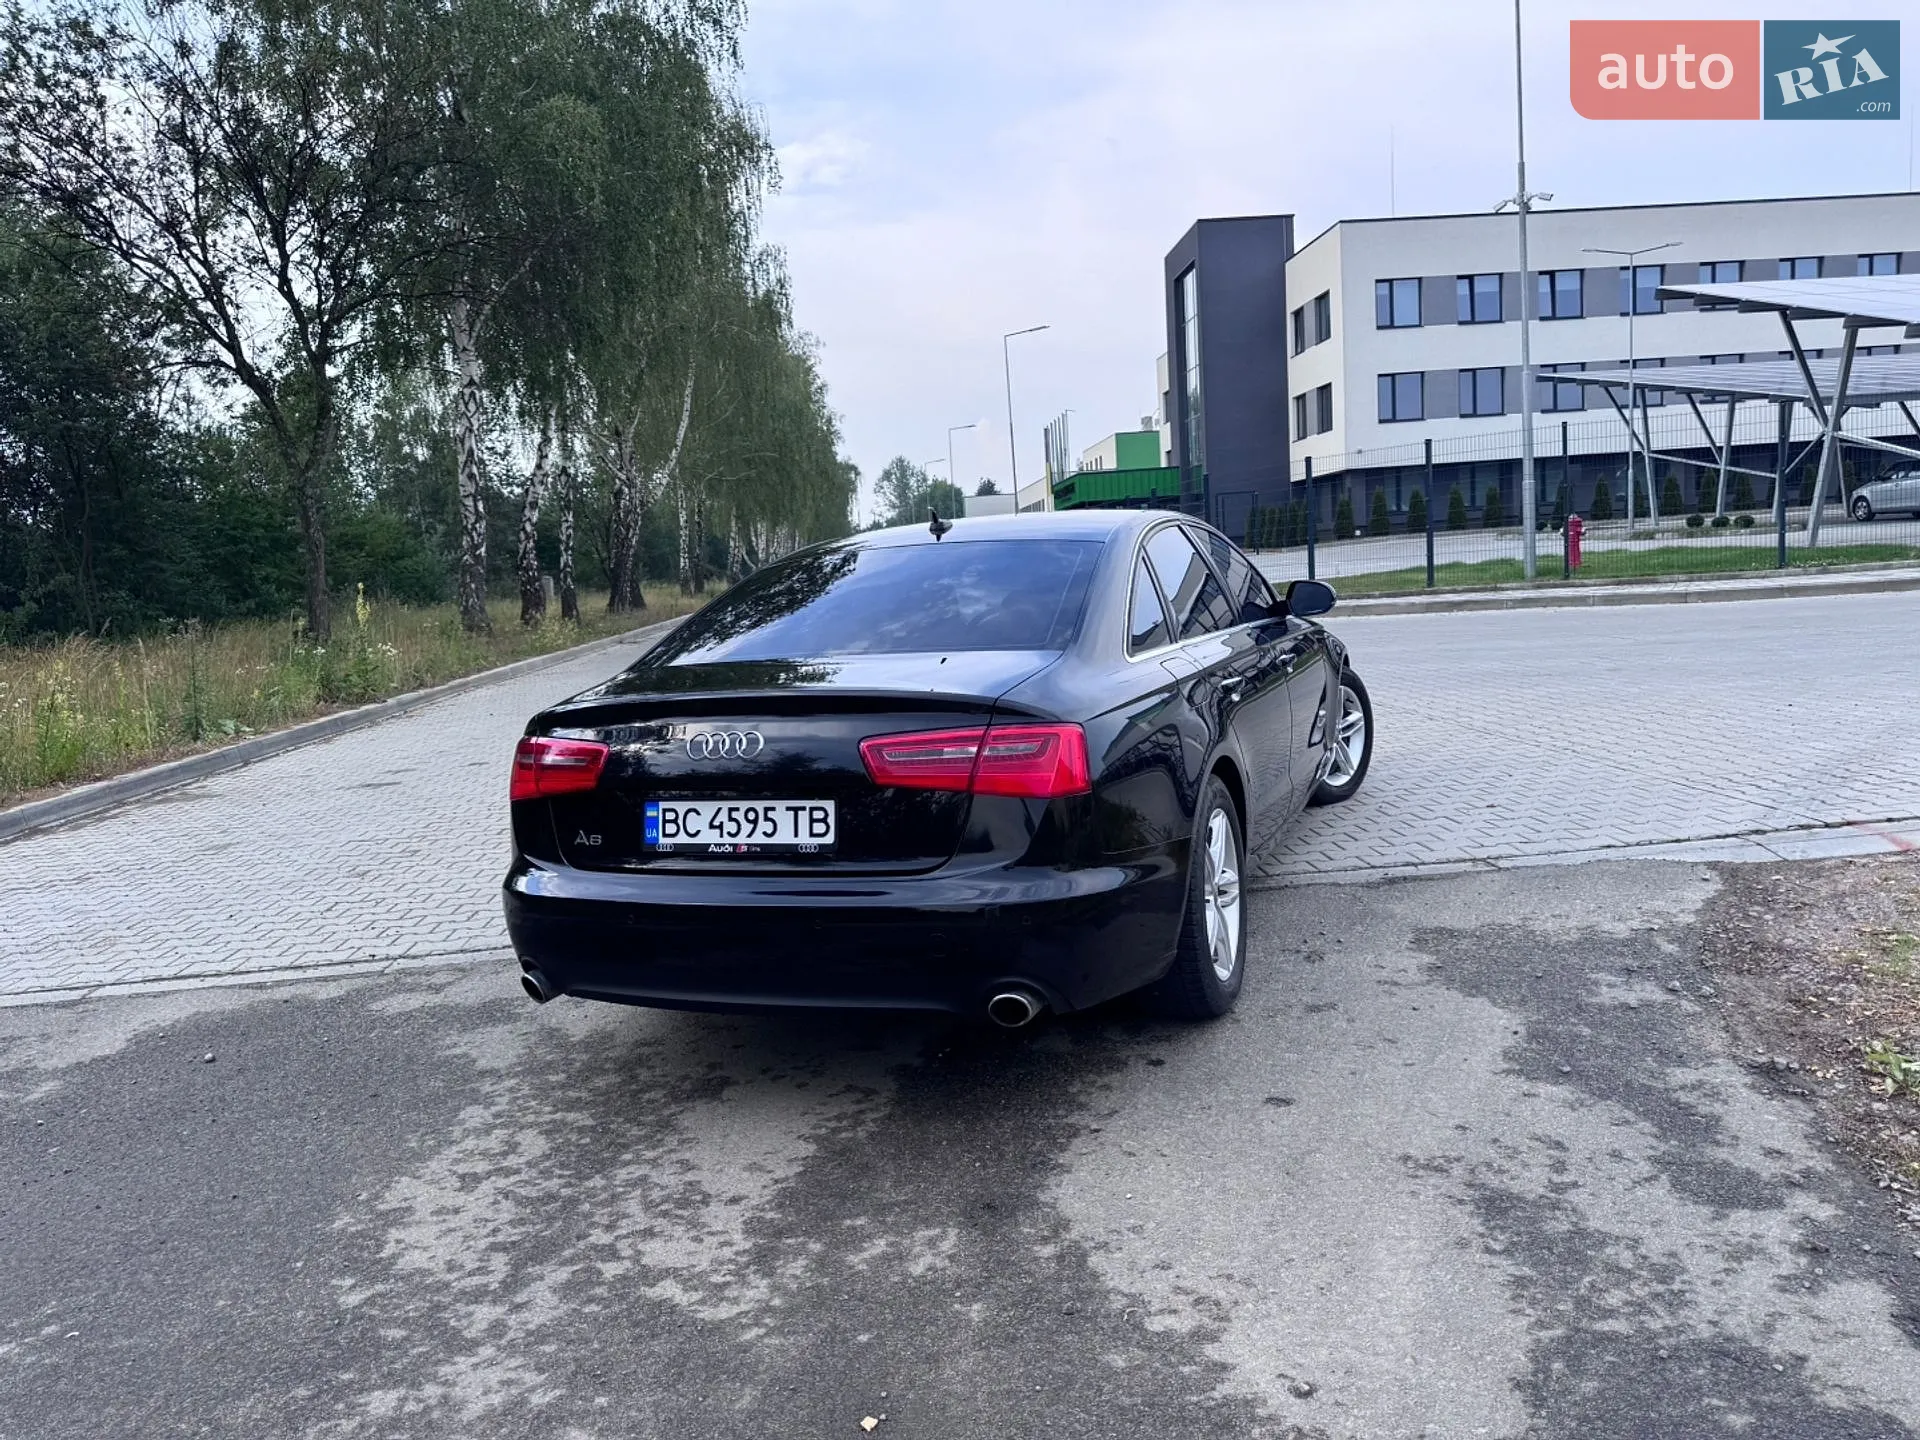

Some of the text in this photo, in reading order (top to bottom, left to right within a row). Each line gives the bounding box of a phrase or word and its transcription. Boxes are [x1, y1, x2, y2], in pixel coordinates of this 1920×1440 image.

[661, 806, 831, 839] BC 4595 TB
[574, 829, 602, 846] A6
[646, 827, 658, 838] UA
[708, 844, 734, 853] Audi
